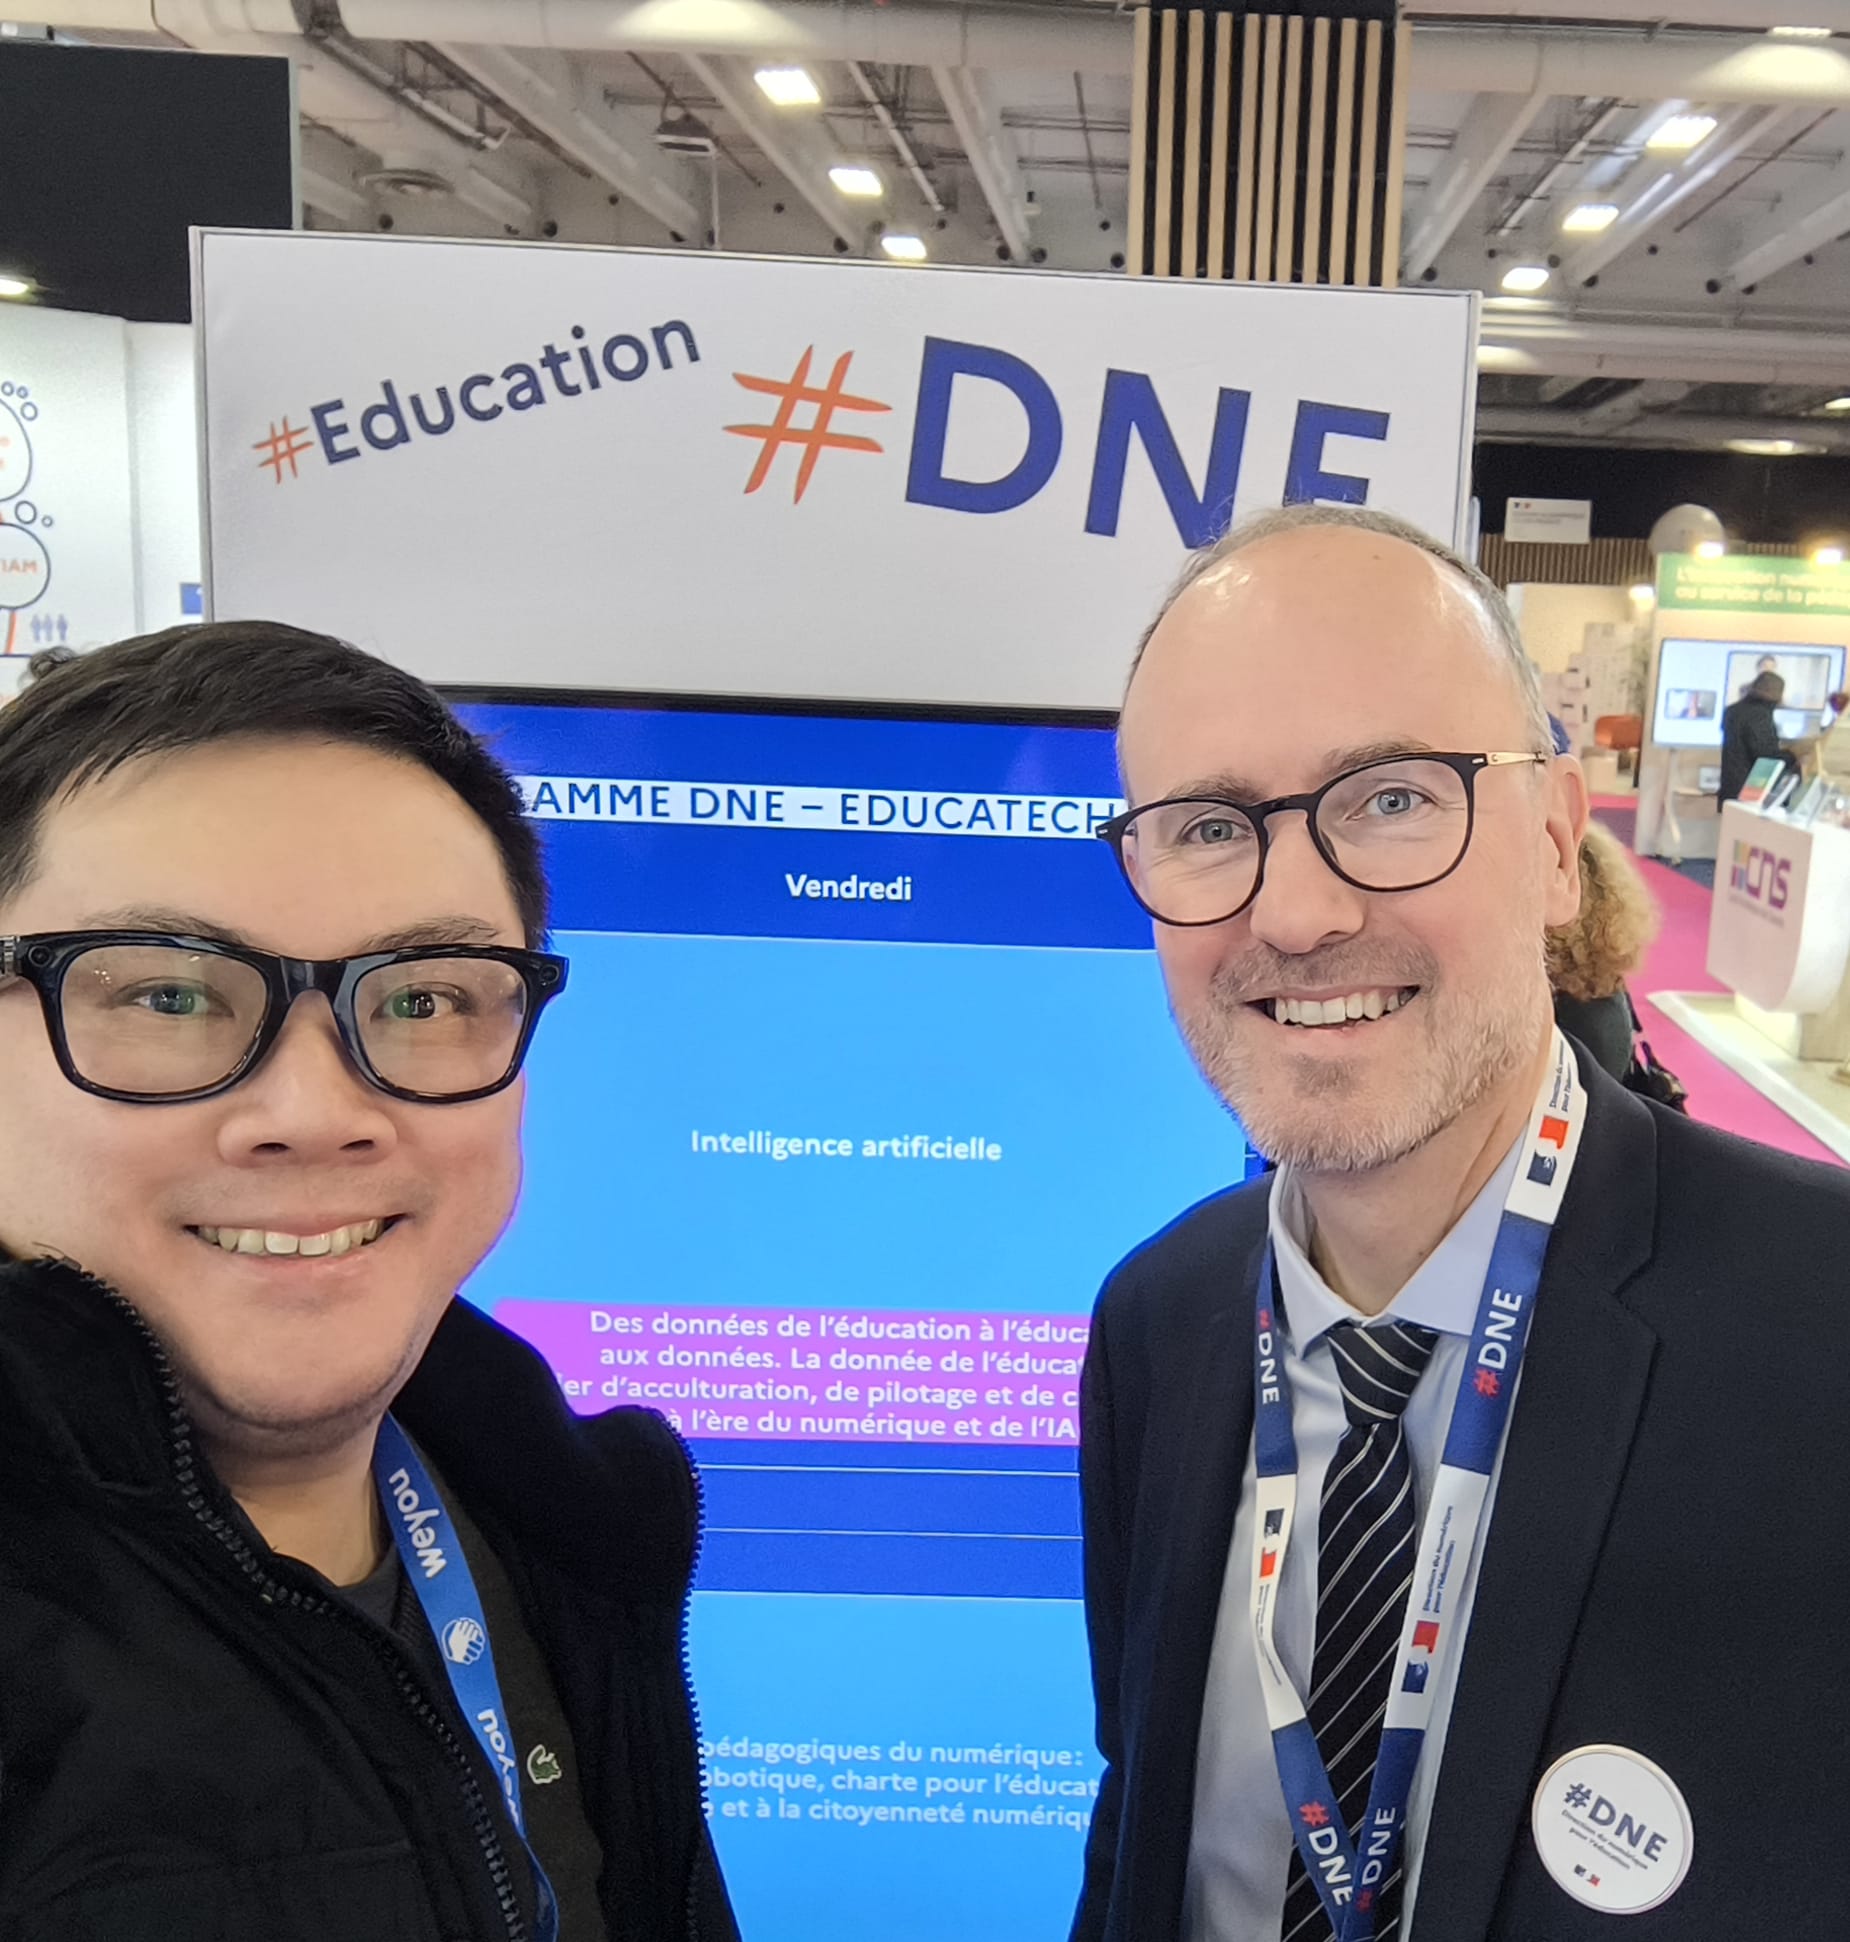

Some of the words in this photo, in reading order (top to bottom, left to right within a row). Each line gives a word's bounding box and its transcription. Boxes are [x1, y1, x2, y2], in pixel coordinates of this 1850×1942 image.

[252, 319, 701, 485] #Education
[722, 335, 1391, 550] #DNE
[532, 782, 670, 817] AMME
[690, 787, 784, 821] DNE
[841, 793, 1114, 834] EDUCATECH
[785, 873, 912, 900] Vendredi
[691, 1130, 853, 1161] Intelligence
[862, 1135, 1003, 1160] artificielle
[590, 1310, 643, 1334] Des
[652, 1312, 768, 1336] données
[777, 1314, 811, 1337] de
[820, 1314, 970, 1341] l'éducation
[979, 1319, 994, 1341] à
[1474, 1288, 1522, 1397] #DNE
[600, 1348, 649, 1366] aux
[657, 1344, 781, 1368] données.
[791, 1347, 820, 1369] La
[830, 1348, 932, 1371] donnée
[940, 1350, 974, 1373] de
[601, 1375, 817, 1404] d'acculturation,
[825, 1381, 859, 1402] de
[868, 1381, 977, 1410] pilotage
[985, 1386, 1013, 1405] et
[1021, 1384, 1054, 1406] de
[692, 1409, 749, 1431] l'ère
[757, 1410, 791, 1432] du
[800, 1413, 946, 1440] numérique
[953, 1417, 982, 1436] et
[990, 1416, 1023, 1437] de
[1031, 1416, 1076, 1438] l'IA
[389, 1468, 447, 1578] weyou
[889, 1740, 922, 1762] du
[832, 1769, 917, 1793] charte
[925, 1776, 988, 1798] pour
[721, 1799, 749, 1818] et
[756, 1797, 771, 1818] à
[778, 1798, 801, 1819] la
[808, 1799, 965, 1827] citoyenneté
[1564, 1783, 1668, 1862] #DNE
